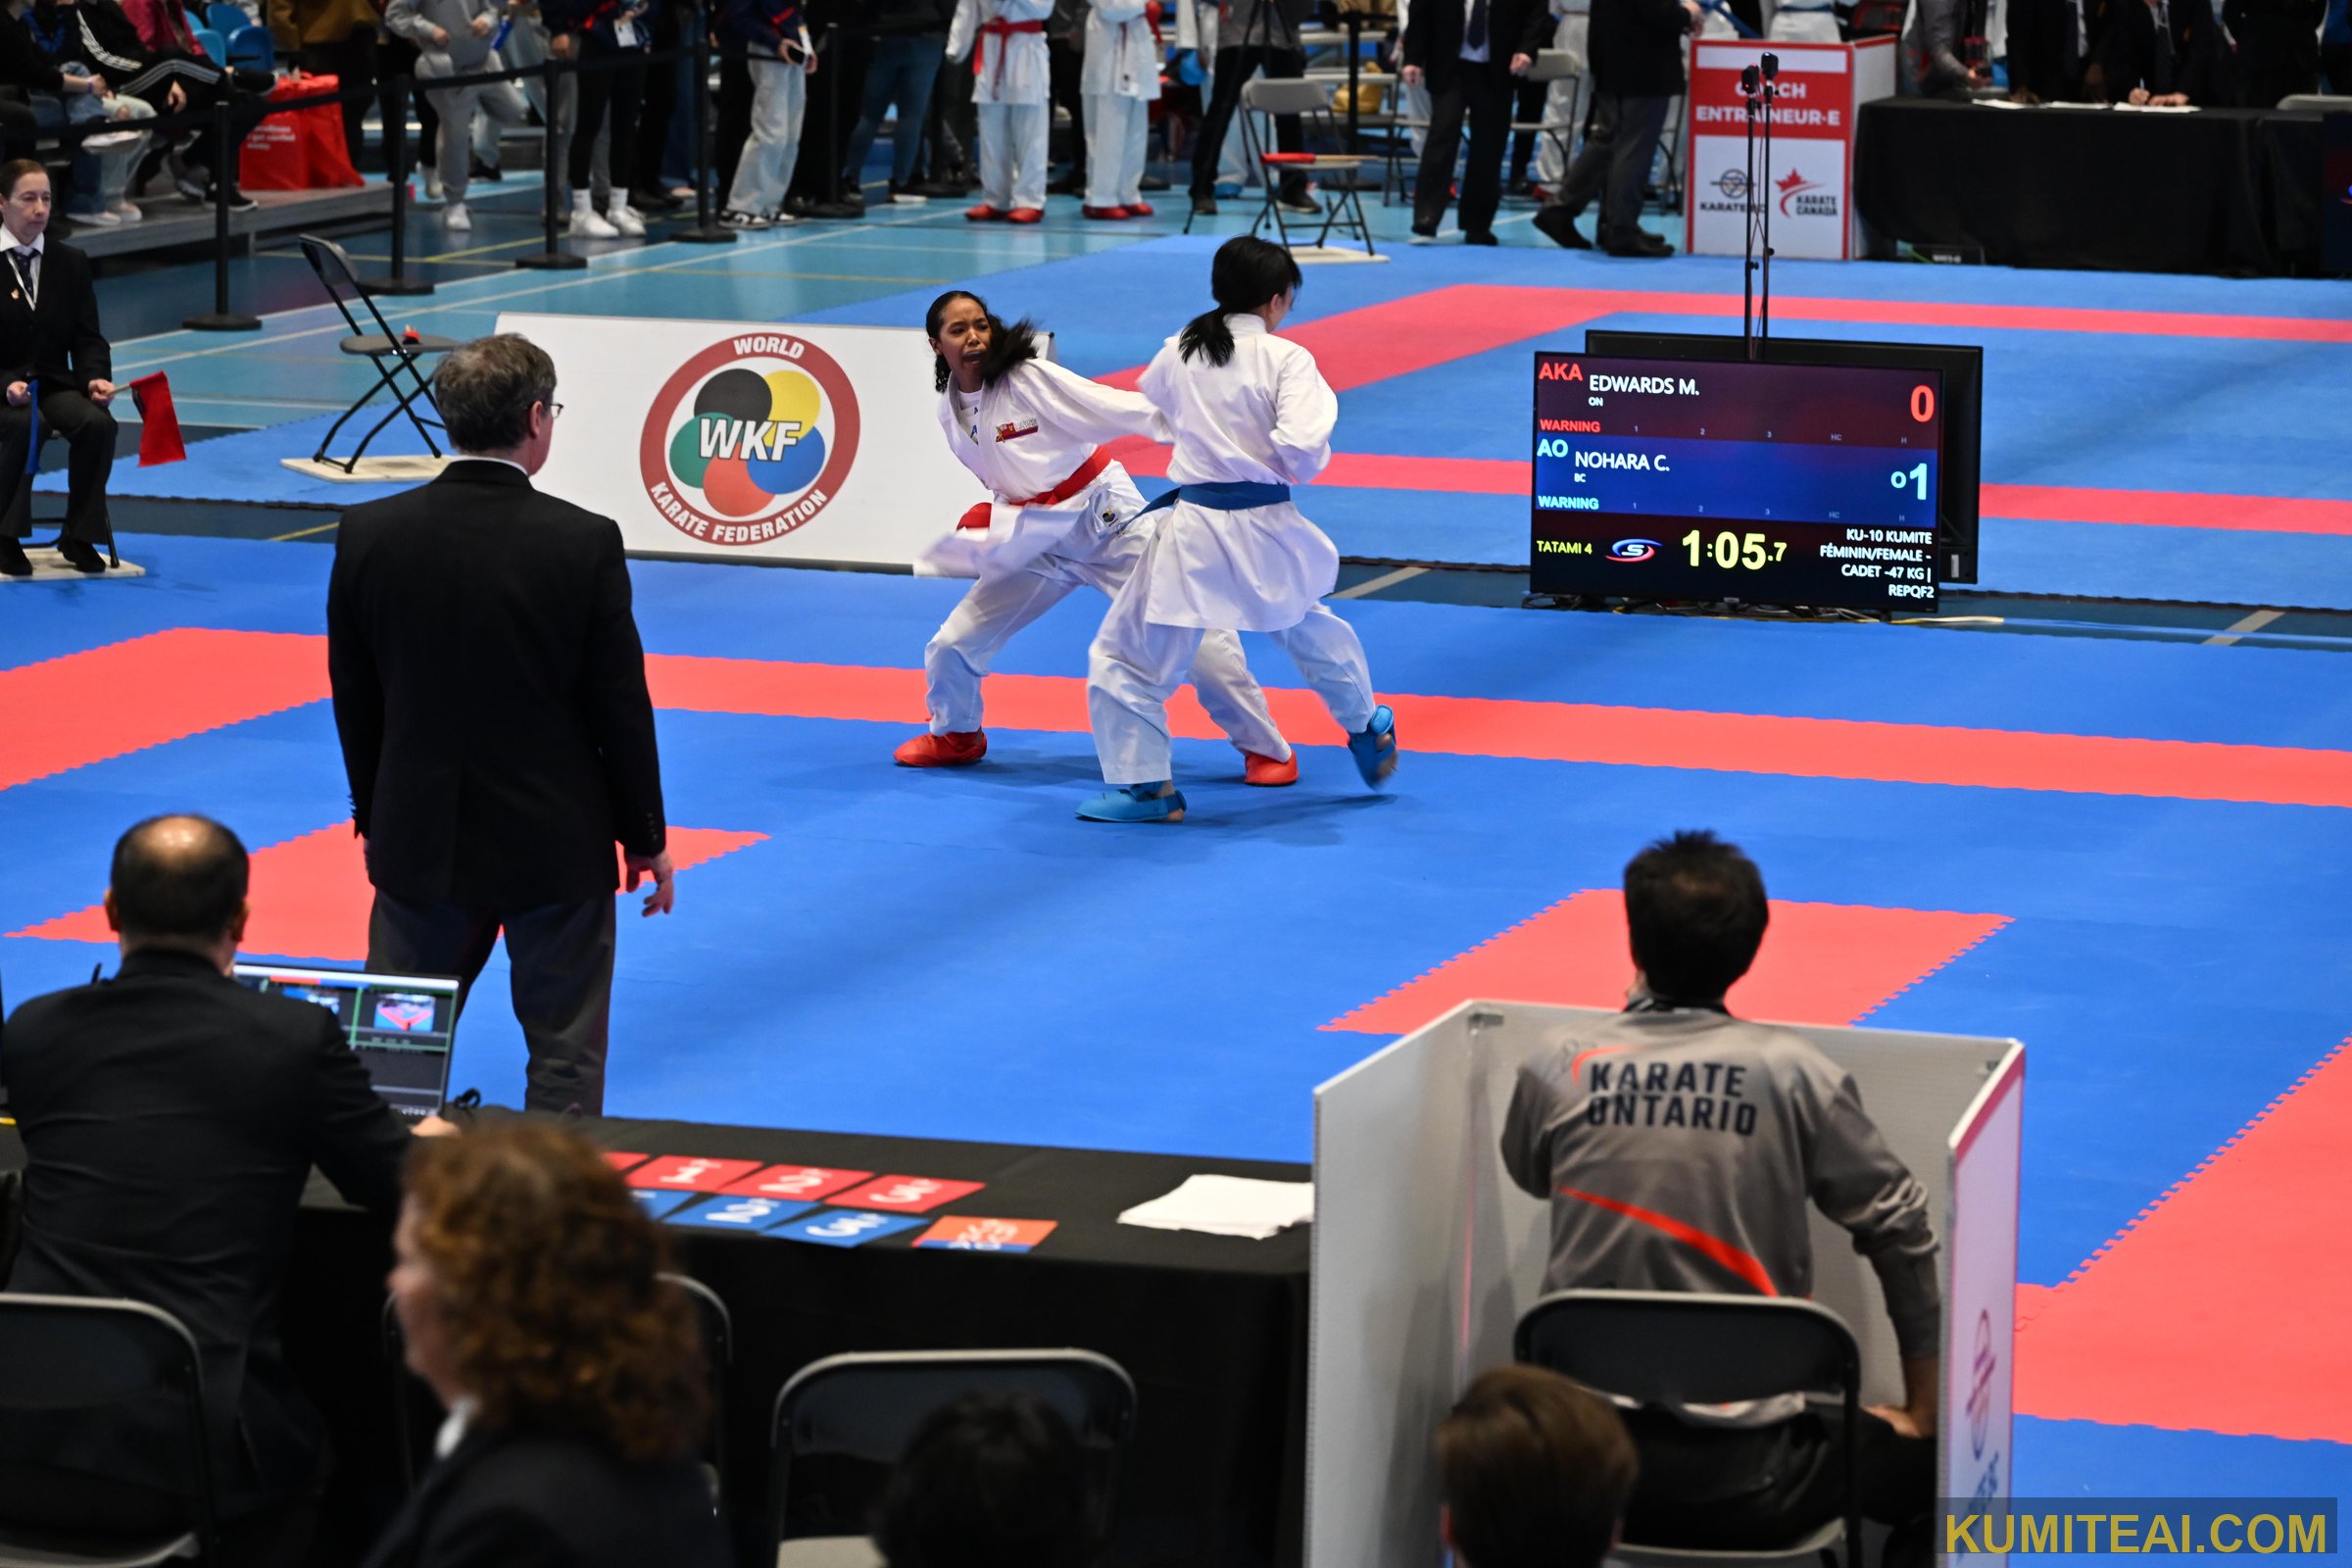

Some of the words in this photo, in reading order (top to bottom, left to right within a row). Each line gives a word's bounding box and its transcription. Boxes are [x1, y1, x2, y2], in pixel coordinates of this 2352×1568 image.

[1700, 201, 1747, 213] KARATE
[1796, 195, 1837, 206] KARATE
[1795, 206, 1838, 216] CANADA
[733, 336, 805, 360] WORLD
[1539, 363, 1583, 381] AKA
[1590, 374, 1675, 394] EDWARDS
[1679, 378, 1699, 396] M.
[1589, 397, 1603, 407] ON
[1911, 385, 1935, 422] 0
[1540, 418, 1600, 433] WARNING
[699, 417, 802, 462] WKF
[1537, 439, 1568, 458] AO
[1575, 451, 1649, 470] NOHARA
[1654, 455, 1670, 471] C.
[1574, 472, 1586, 483] BC
[1538, 495, 1598, 510] WARNING
[650, 481, 710, 537] KARATE
[711, 489, 828, 542] FEDERATION
[1846, 528, 1884, 542] KU-10
[1886, 530, 1933, 544] KUMITE
[1536, 540, 1582, 554] TATAMI
[1584, 543, 1592, 555] 4
[1820, 542, 1923, 562] FÉMININ/FEMALE
[1841, 564, 1882, 577] CADET
[1884, 566, 1904, 578] -47
[1906, 567, 1925, 580] KG
[1888, 584, 1935, 599] REPQF2
[1590, 1062, 1746, 1098] KARATE
[1588, 1095, 1757, 1137] ONTARIO
